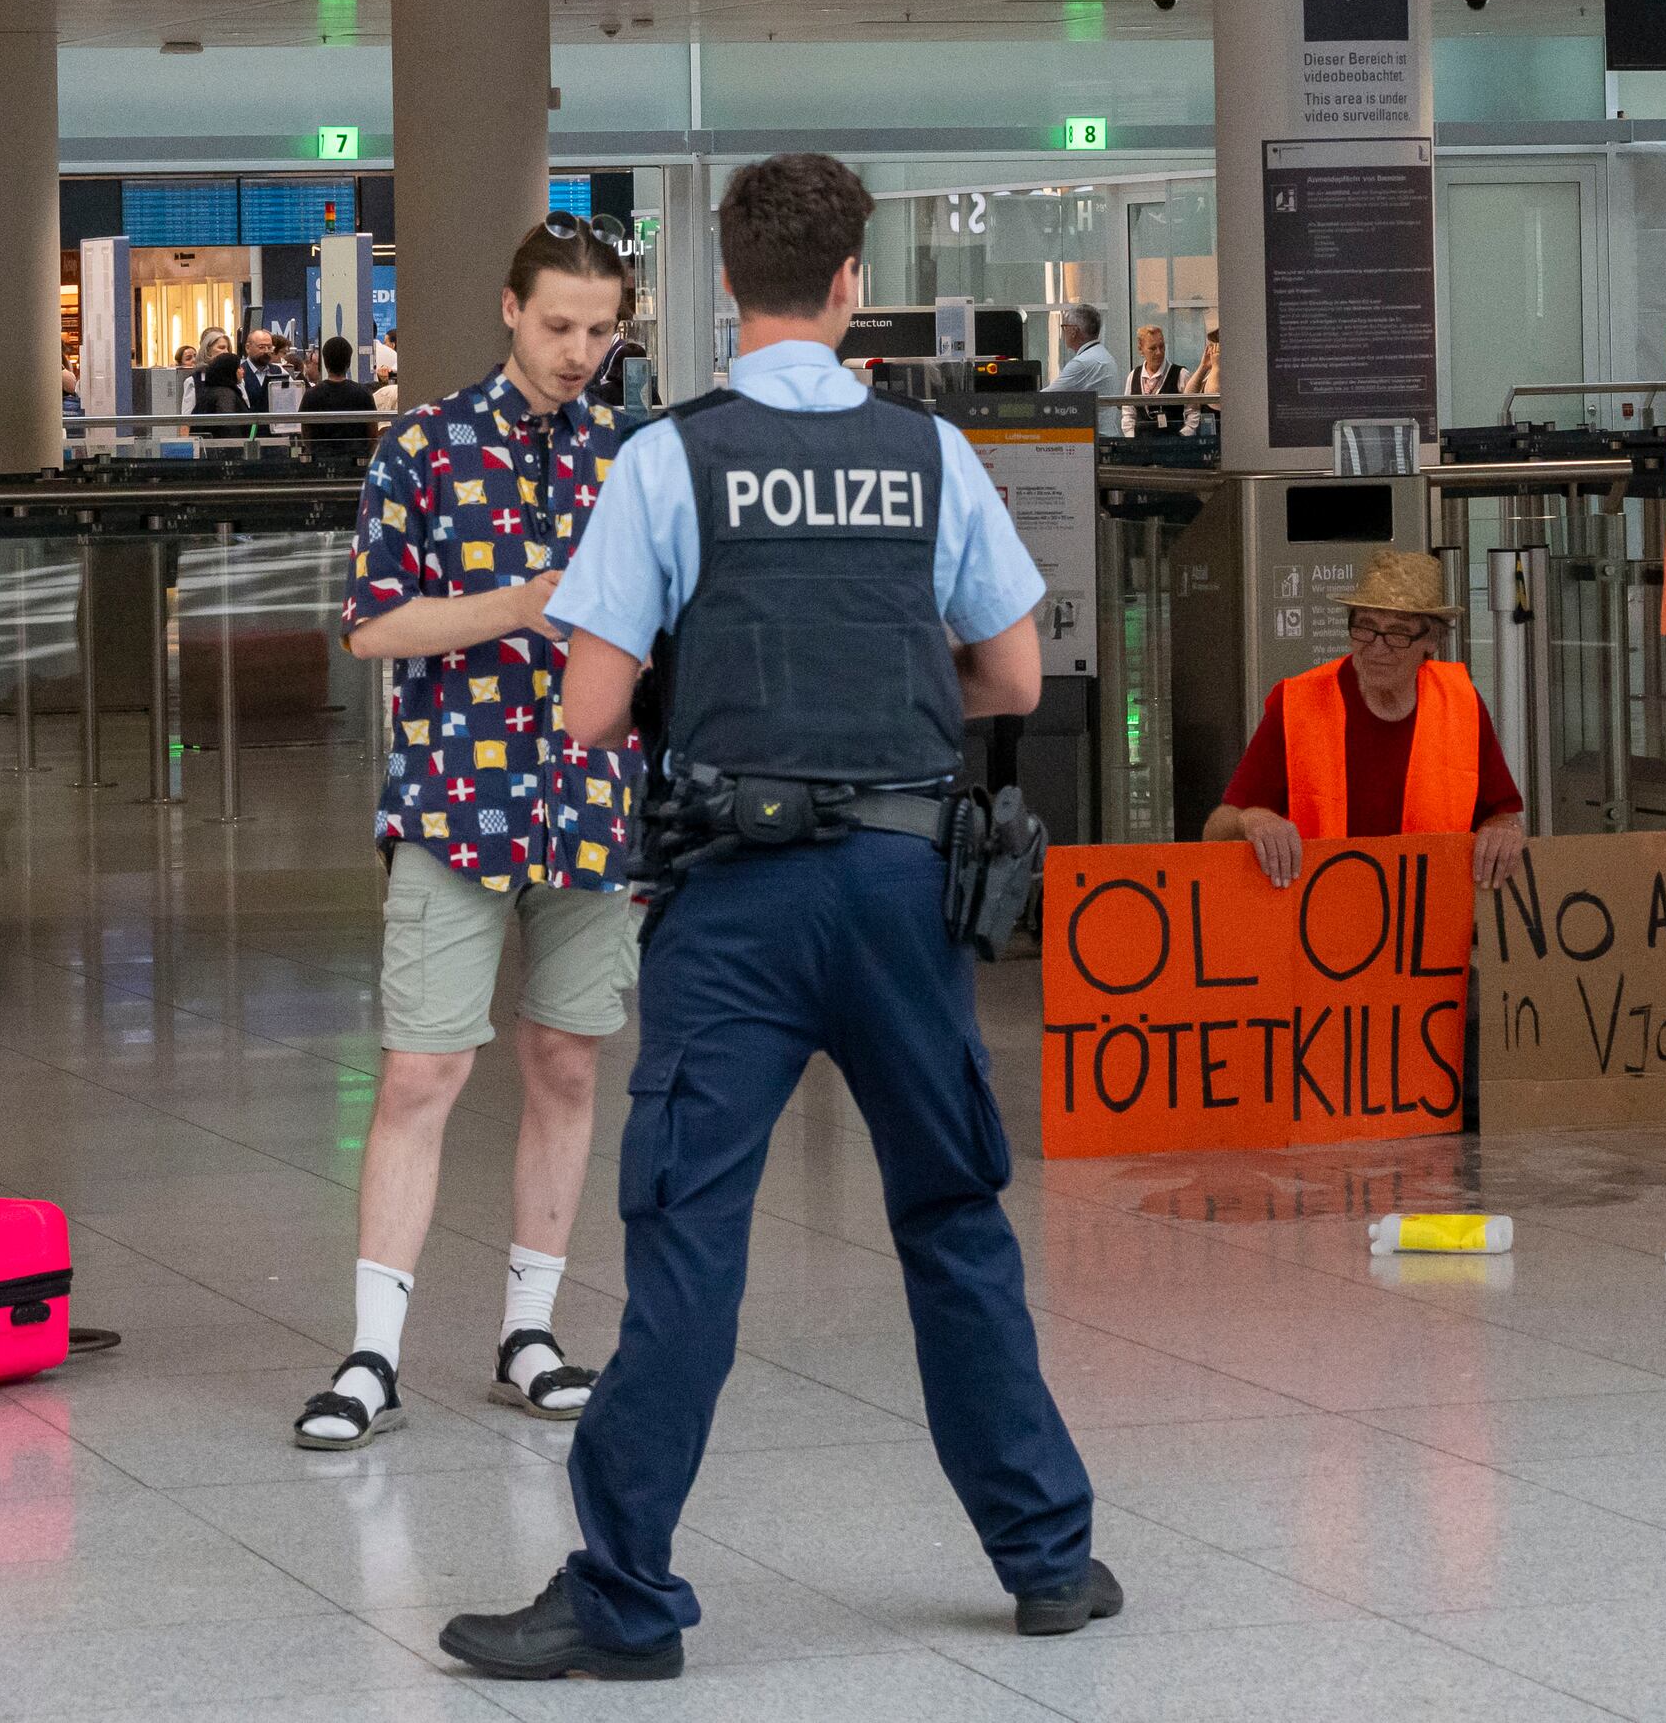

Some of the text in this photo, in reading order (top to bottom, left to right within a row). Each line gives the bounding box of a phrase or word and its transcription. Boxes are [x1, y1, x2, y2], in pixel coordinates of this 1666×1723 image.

[1304, 52, 1407, 66] Dieser Bereich ist
[1304, 70, 1405, 83] videobeobachtet.
[1304, 92, 1408, 106] This area is under
[1305, 109, 1410, 123] video surveillance.
[1085, 125, 1096, 144] 8
[335, 135, 348, 153] 7
[726, 469, 924, 529] POLIZEI
[1312, 564, 1353, 580] Abfall
[1494, 846, 1615, 963] NO
[1068, 849, 1464, 995] ÖL OIL
[1503, 989, 1539, 1051] in
[1046, 1000, 1462, 1122] TÖTET KILLS
